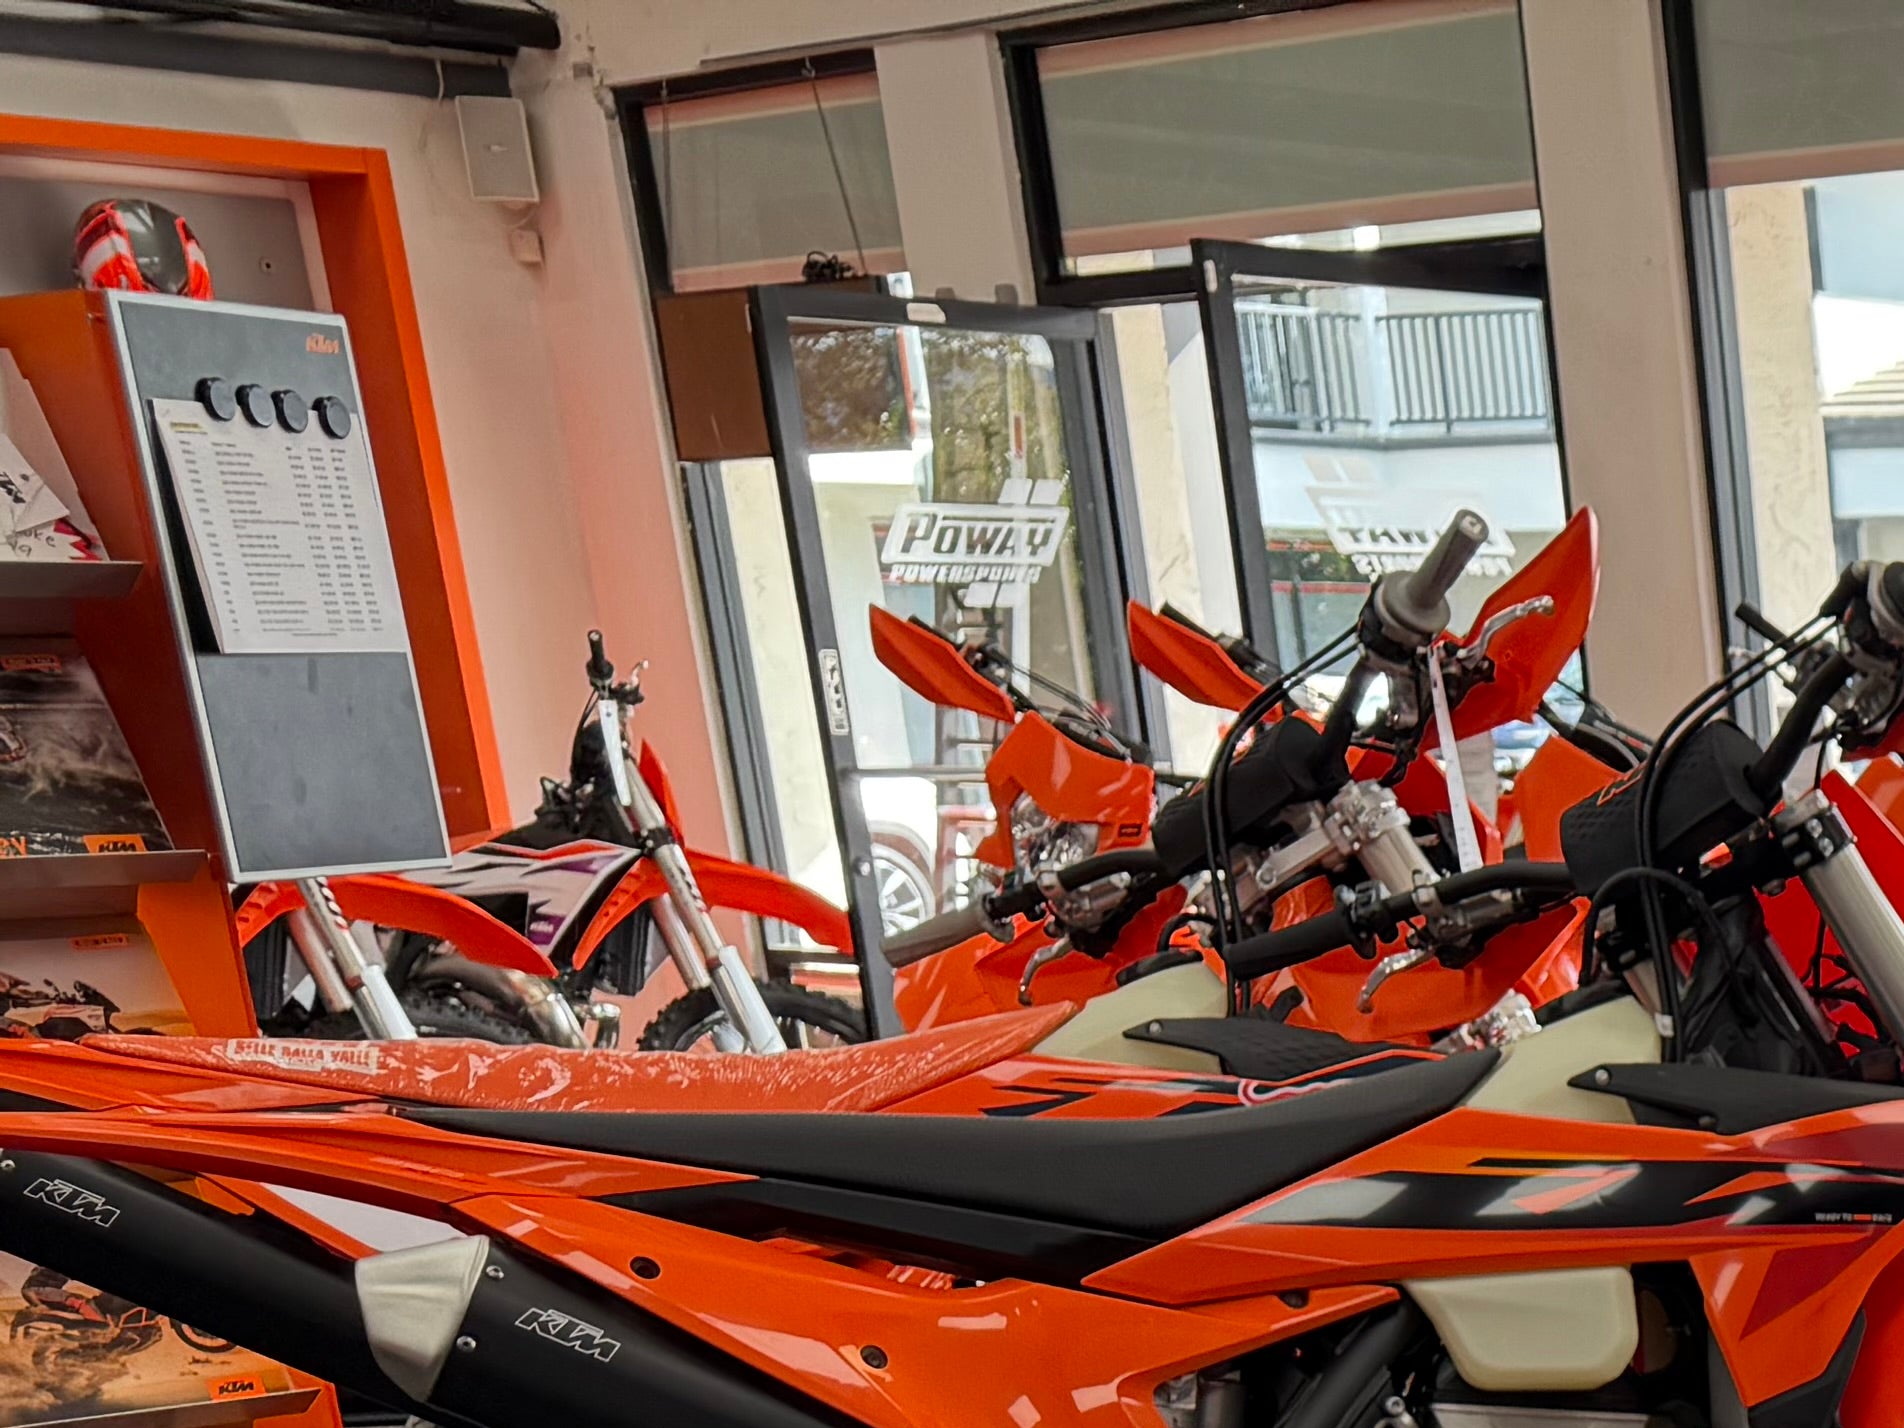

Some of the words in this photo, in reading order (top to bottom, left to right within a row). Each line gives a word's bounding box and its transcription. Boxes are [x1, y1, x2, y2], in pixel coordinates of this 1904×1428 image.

[306, 333, 341, 355] KTM
[901, 513, 1053, 556] POWAY
[22, 1178, 120, 1228] KTM
[514, 1307, 622, 1363] KTM
[218, 1381, 257, 1397] KTM
